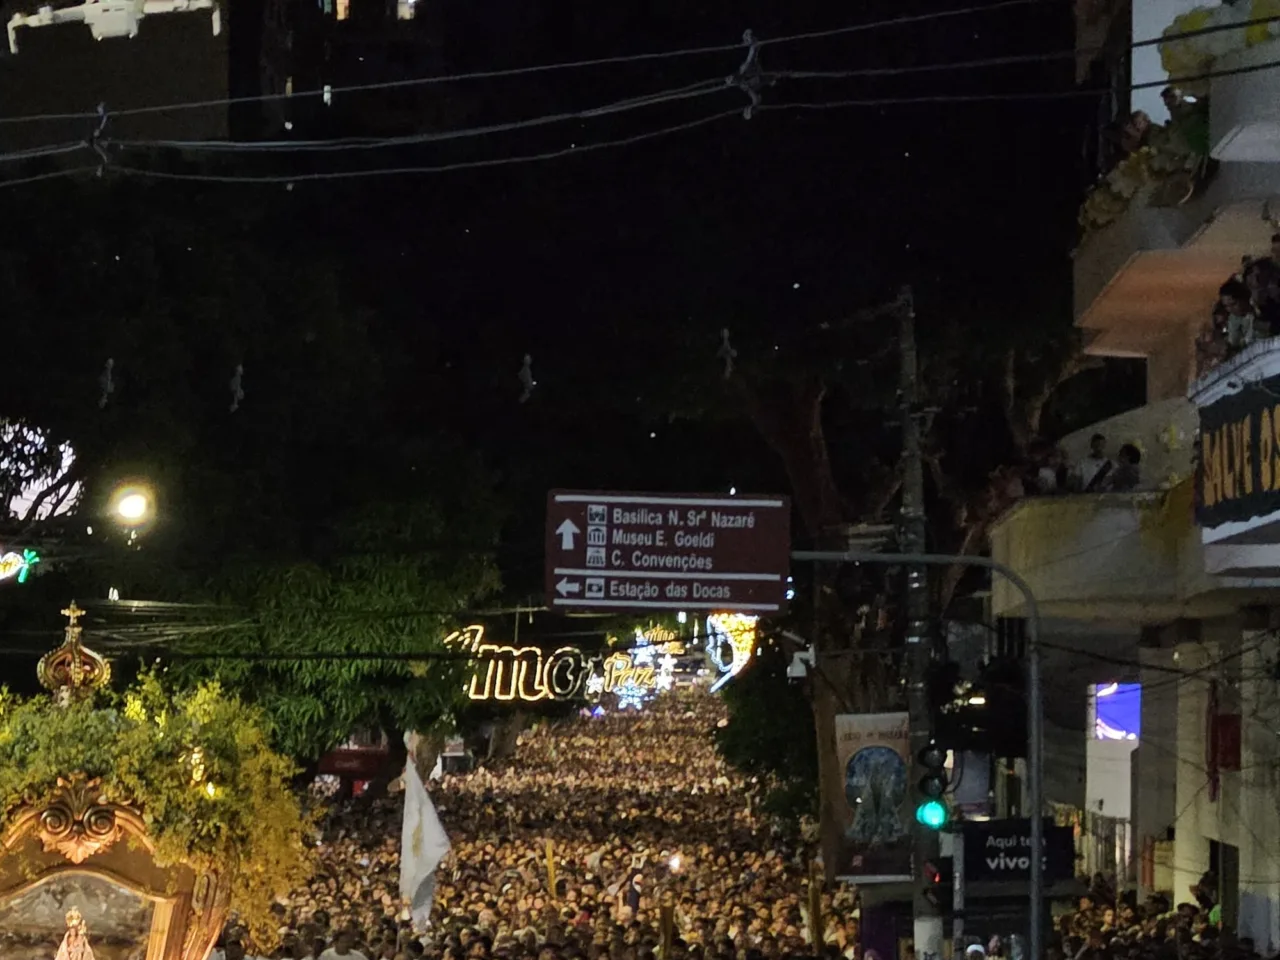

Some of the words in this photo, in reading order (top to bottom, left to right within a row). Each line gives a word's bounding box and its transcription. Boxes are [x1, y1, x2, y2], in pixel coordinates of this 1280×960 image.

[613, 509, 662, 525] Basílica
[668, 511, 684, 526] N.
[711, 512, 755, 528] Nazaré
[612, 529, 652, 546] Museu
[655, 531, 668, 547] E.
[674, 532, 715, 548] Goeldi
[611, 550, 624, 567] C.
[632, 552, 713, 571] Convenções
[610, 581, 660, 600] Estação
[665, 583, 688, 598] das
[693, 583, 730, 598] Docas
[986, 835, 1017, 849] Aqui
[1020, 836, 1046, 846] te
[985, 852, 1029, 870] vivo
